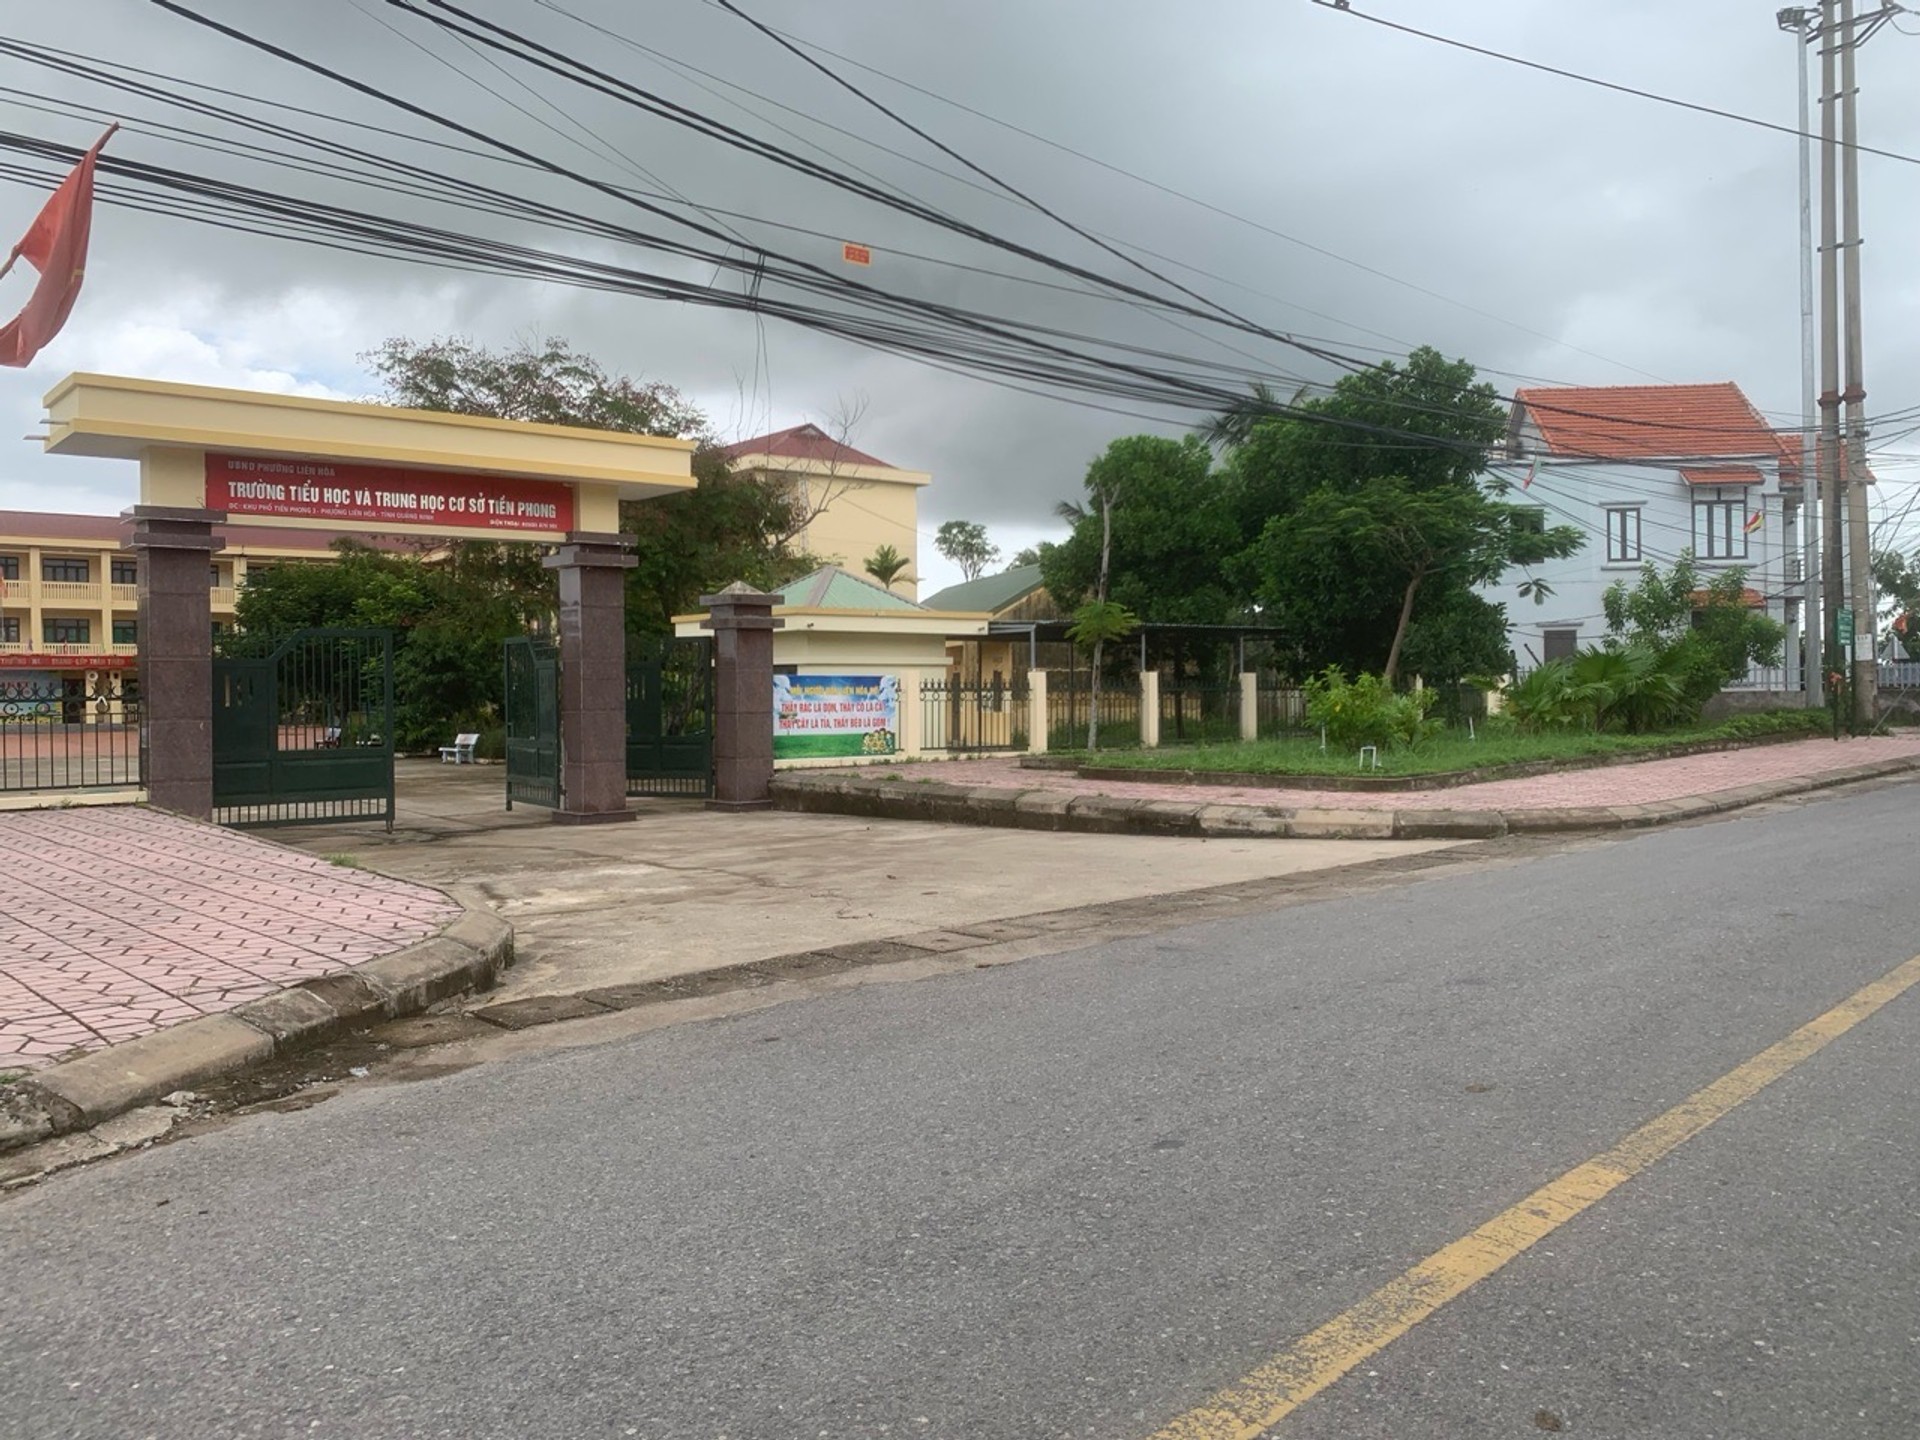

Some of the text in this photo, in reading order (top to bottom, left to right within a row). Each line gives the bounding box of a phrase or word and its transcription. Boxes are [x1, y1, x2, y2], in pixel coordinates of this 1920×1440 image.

[227, 460, 255, 471] UBND
[296, 464, 316, 475] LIÊN
[228, 478, 285, 500] TRƯỜNG
[289, 479, 319, 502] TIỂU
[324, 487, 350, 508] HỌC
[354, 487, 372, 506] VÀ
[375, 491, 417, 509] TRUNG
[420, 494, 445, 513] HỌC
[449, 496, 465, 512] CƠ
[469, 492, 486, 514] SỞ
[517, 501, 557, 519] PHONG
[242, 503, 258, 511] KHU
[258, 502, 273, 512] PHỐ
[289, 505, 311, 514] PHONG
